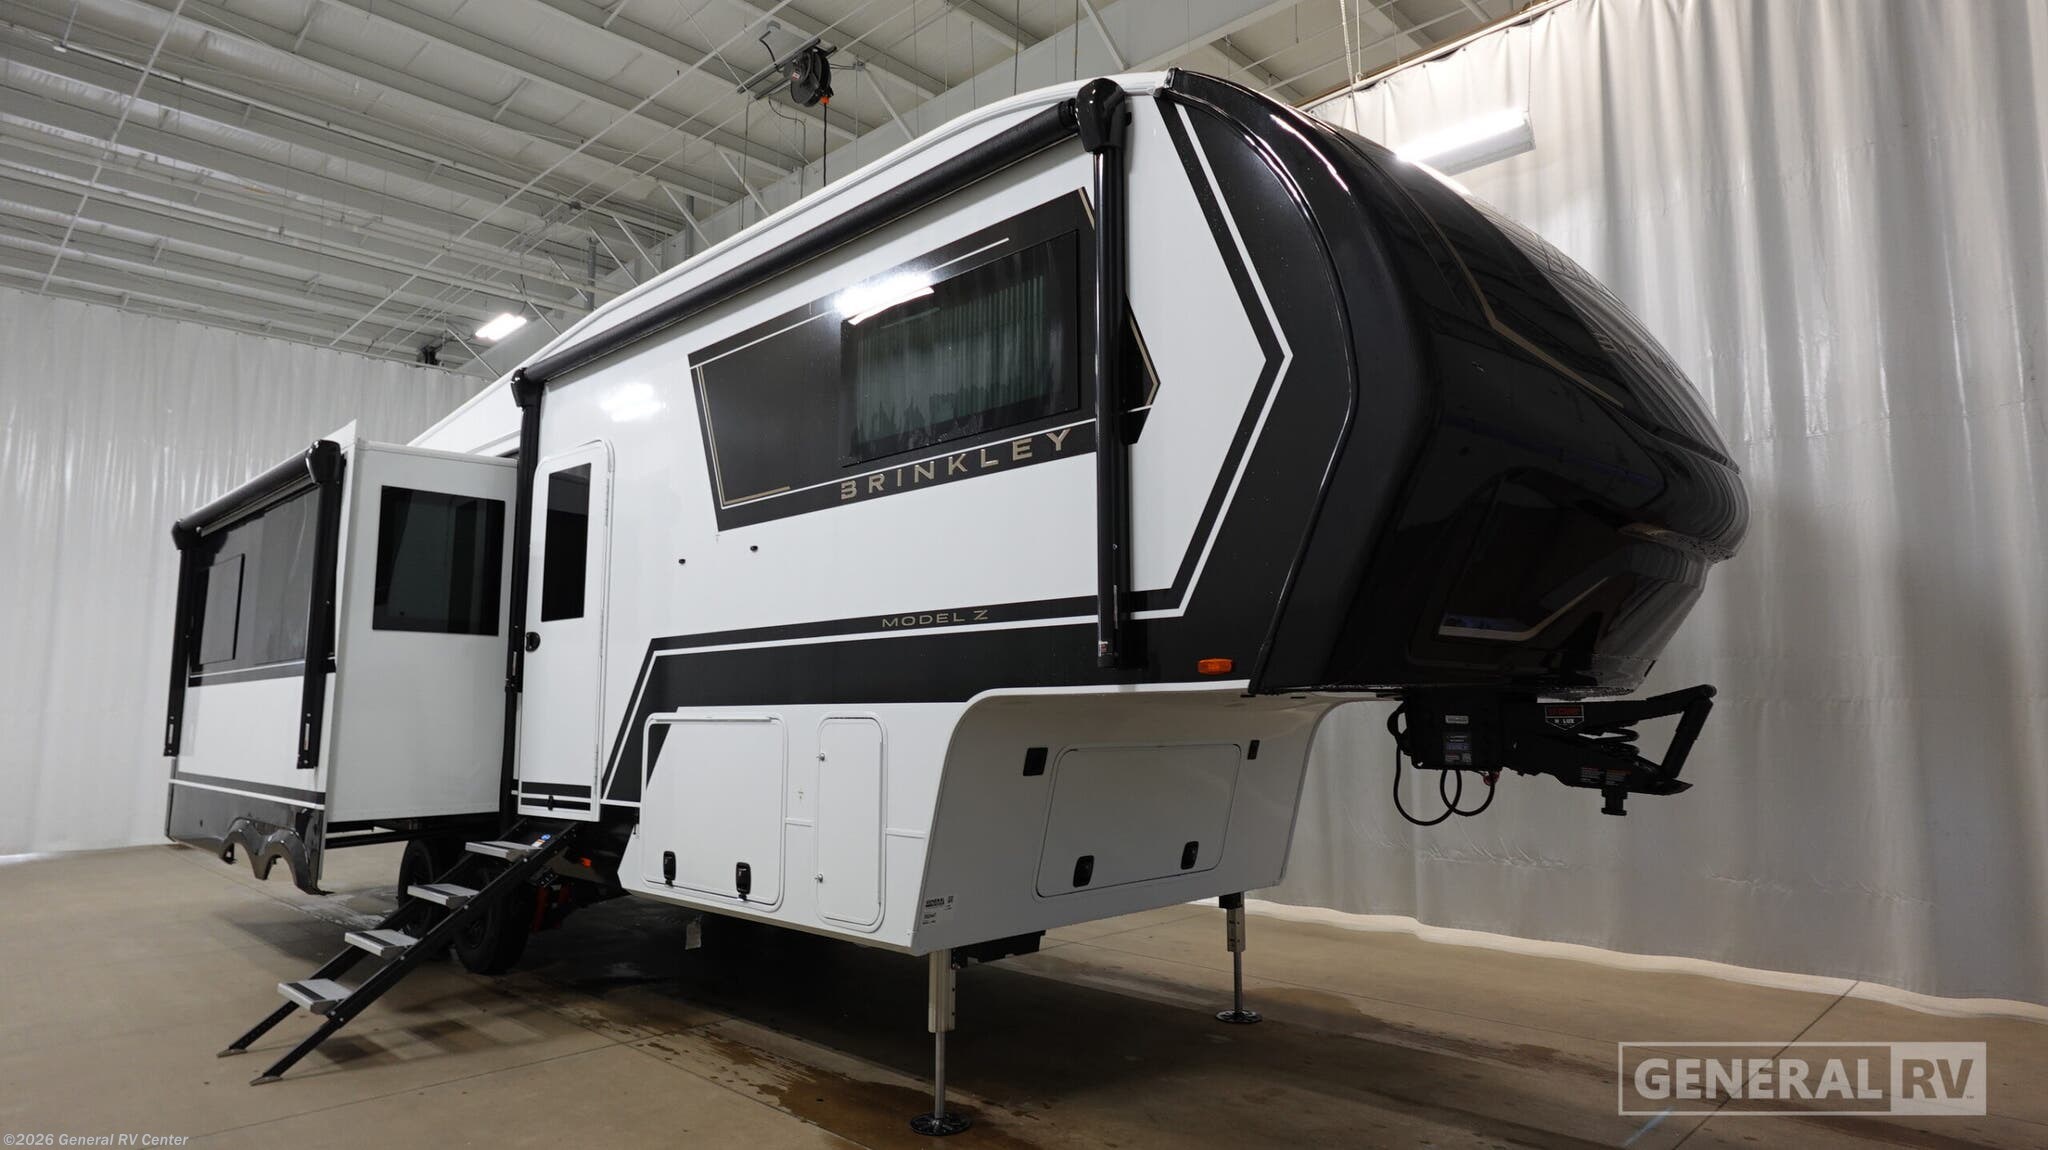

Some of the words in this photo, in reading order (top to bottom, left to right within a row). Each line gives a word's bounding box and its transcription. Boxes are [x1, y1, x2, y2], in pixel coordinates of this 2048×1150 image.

[840, 428, 1072, 500] BRINKLEY
[882, 611, 966, 628] MODEL
[974, 609, 989, 620] Z
